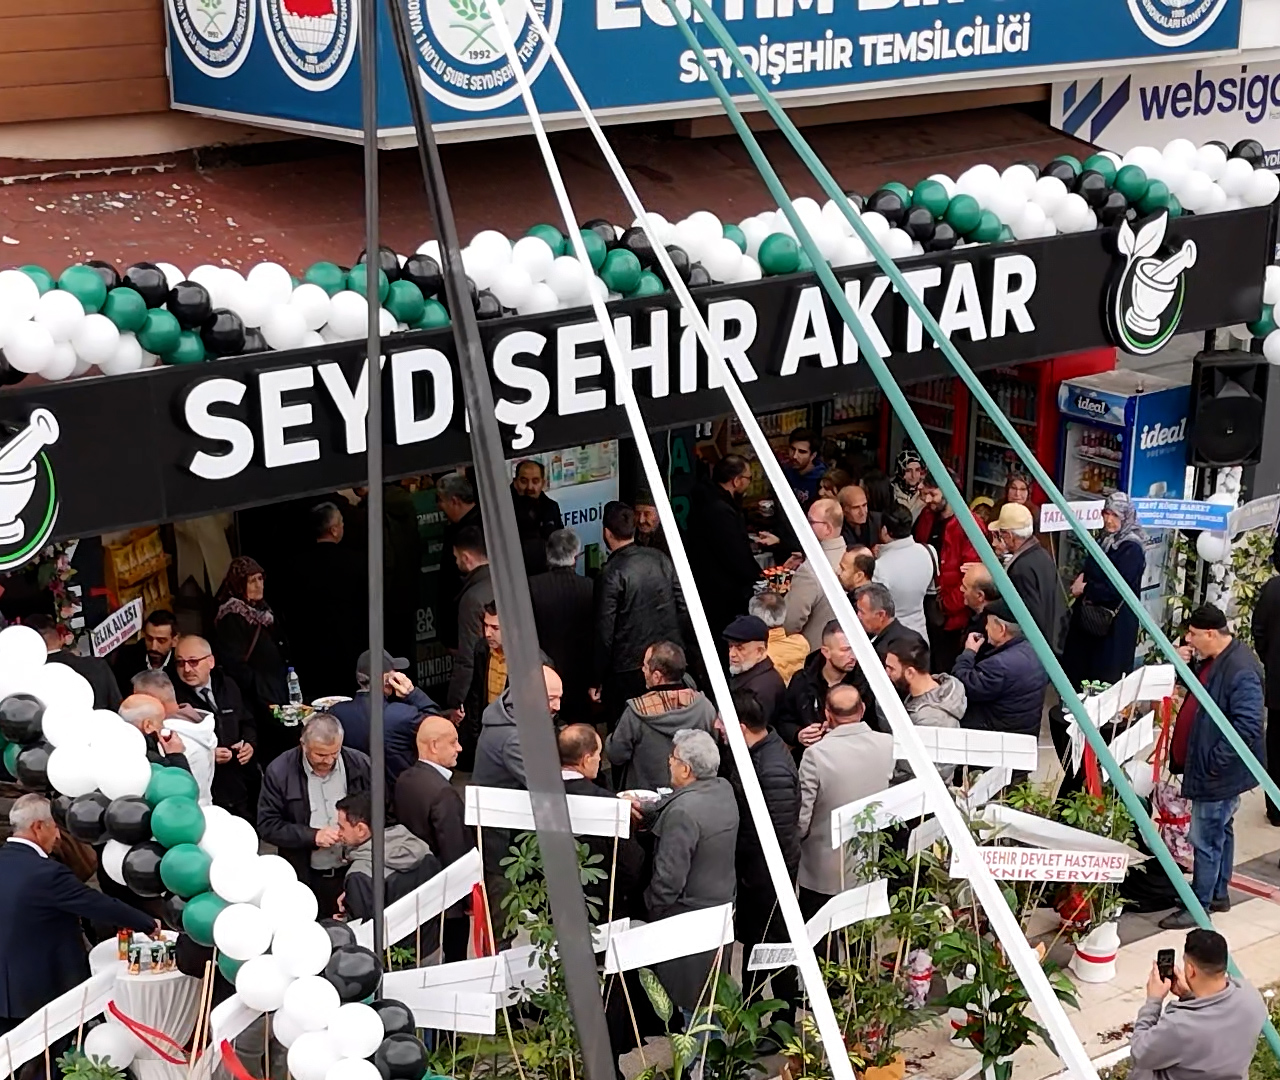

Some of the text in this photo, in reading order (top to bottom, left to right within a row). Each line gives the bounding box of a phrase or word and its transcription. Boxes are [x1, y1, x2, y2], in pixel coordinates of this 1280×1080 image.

[468, 50, 491, 60] 1992
[679, 12, 1030, 84] SEYDİŞEHİR TEMSİLCİLİĞİ
[443, 65, 469, 91] ŞUBE
[470, 60, 515, 91] SEYDİŞEH
[184, 254, 1037, 480] SEYDŞEHİR AKTAR
[1077, 396, 1106, 415] ideal
[1140, 417, 1187, 450] ideal
[1020, 852, 1063, 867] DEVLET
[989, 867, 1037, 879] KNIK
